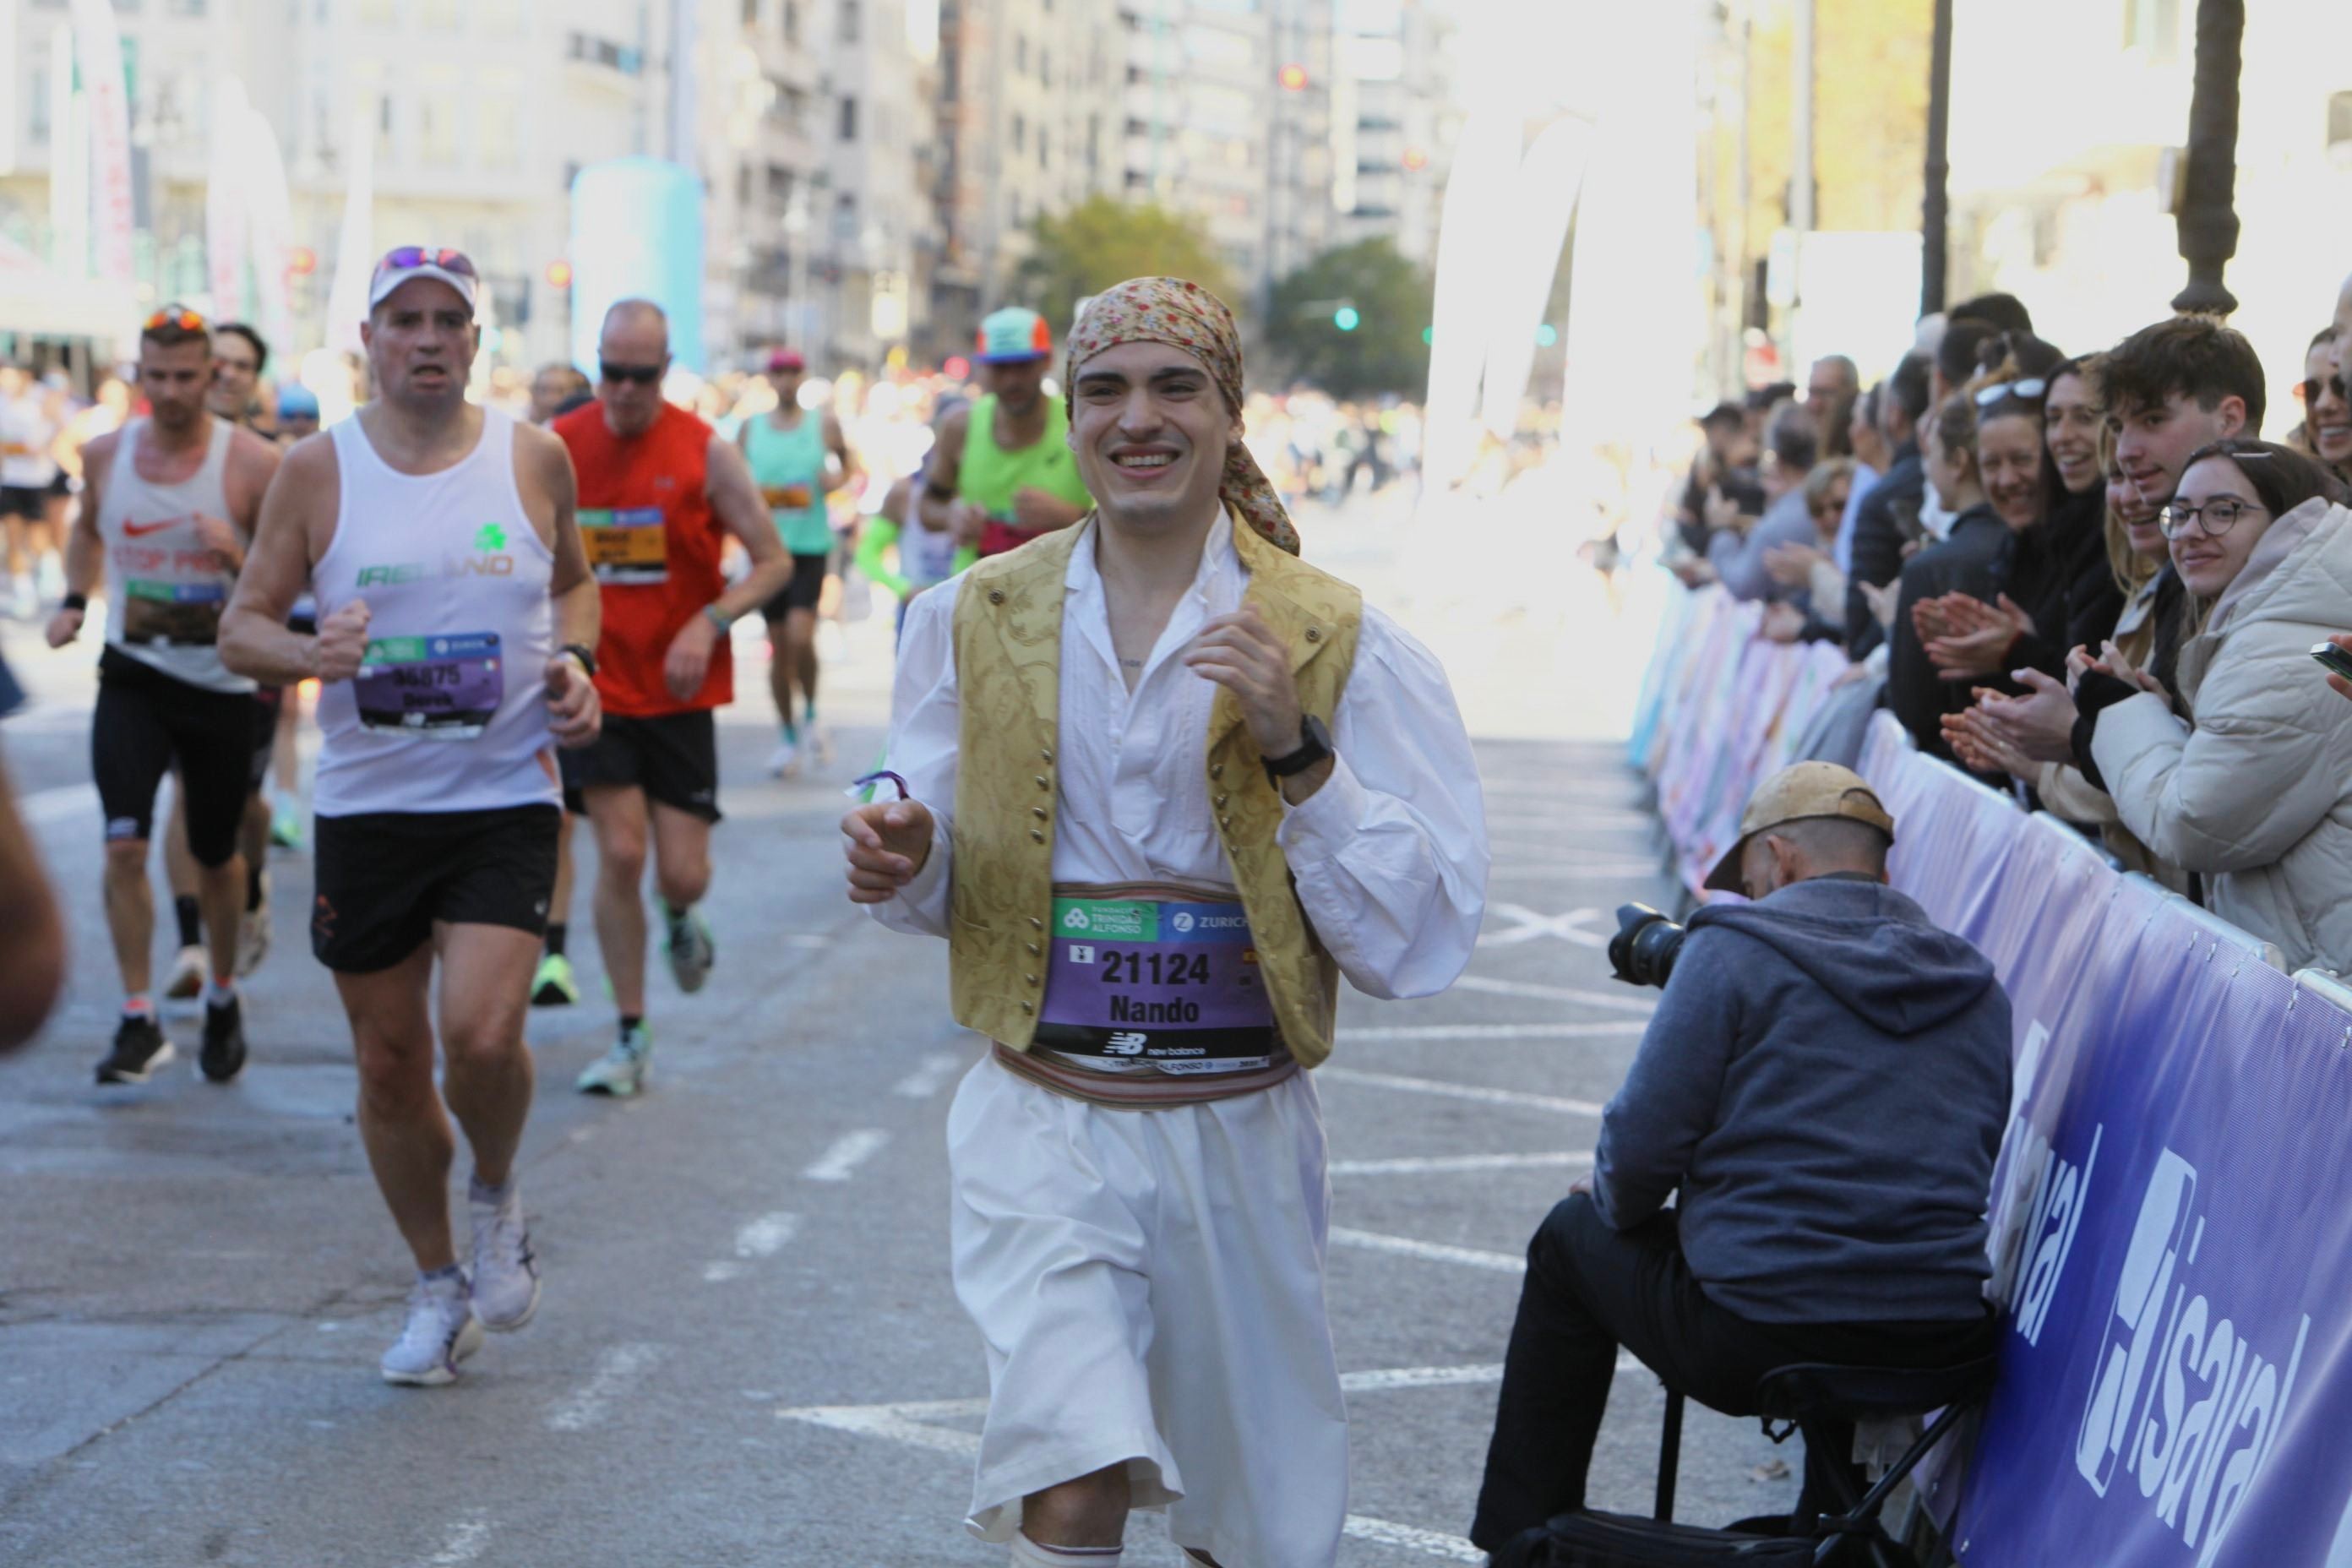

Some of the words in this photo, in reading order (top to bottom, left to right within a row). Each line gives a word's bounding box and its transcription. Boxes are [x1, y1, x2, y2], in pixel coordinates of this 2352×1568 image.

[1092, 906, 1142, 916] FUNDACIN
[1092, 914, 1141, 924] TRINIDAD
[1092, 923, 1141, 934] ALFONSO
[1102, 950, 1210, 984] 21124
[1110, 995, 1200, 1023] Nando
[1168, 1047, 1206, 1055] balance
